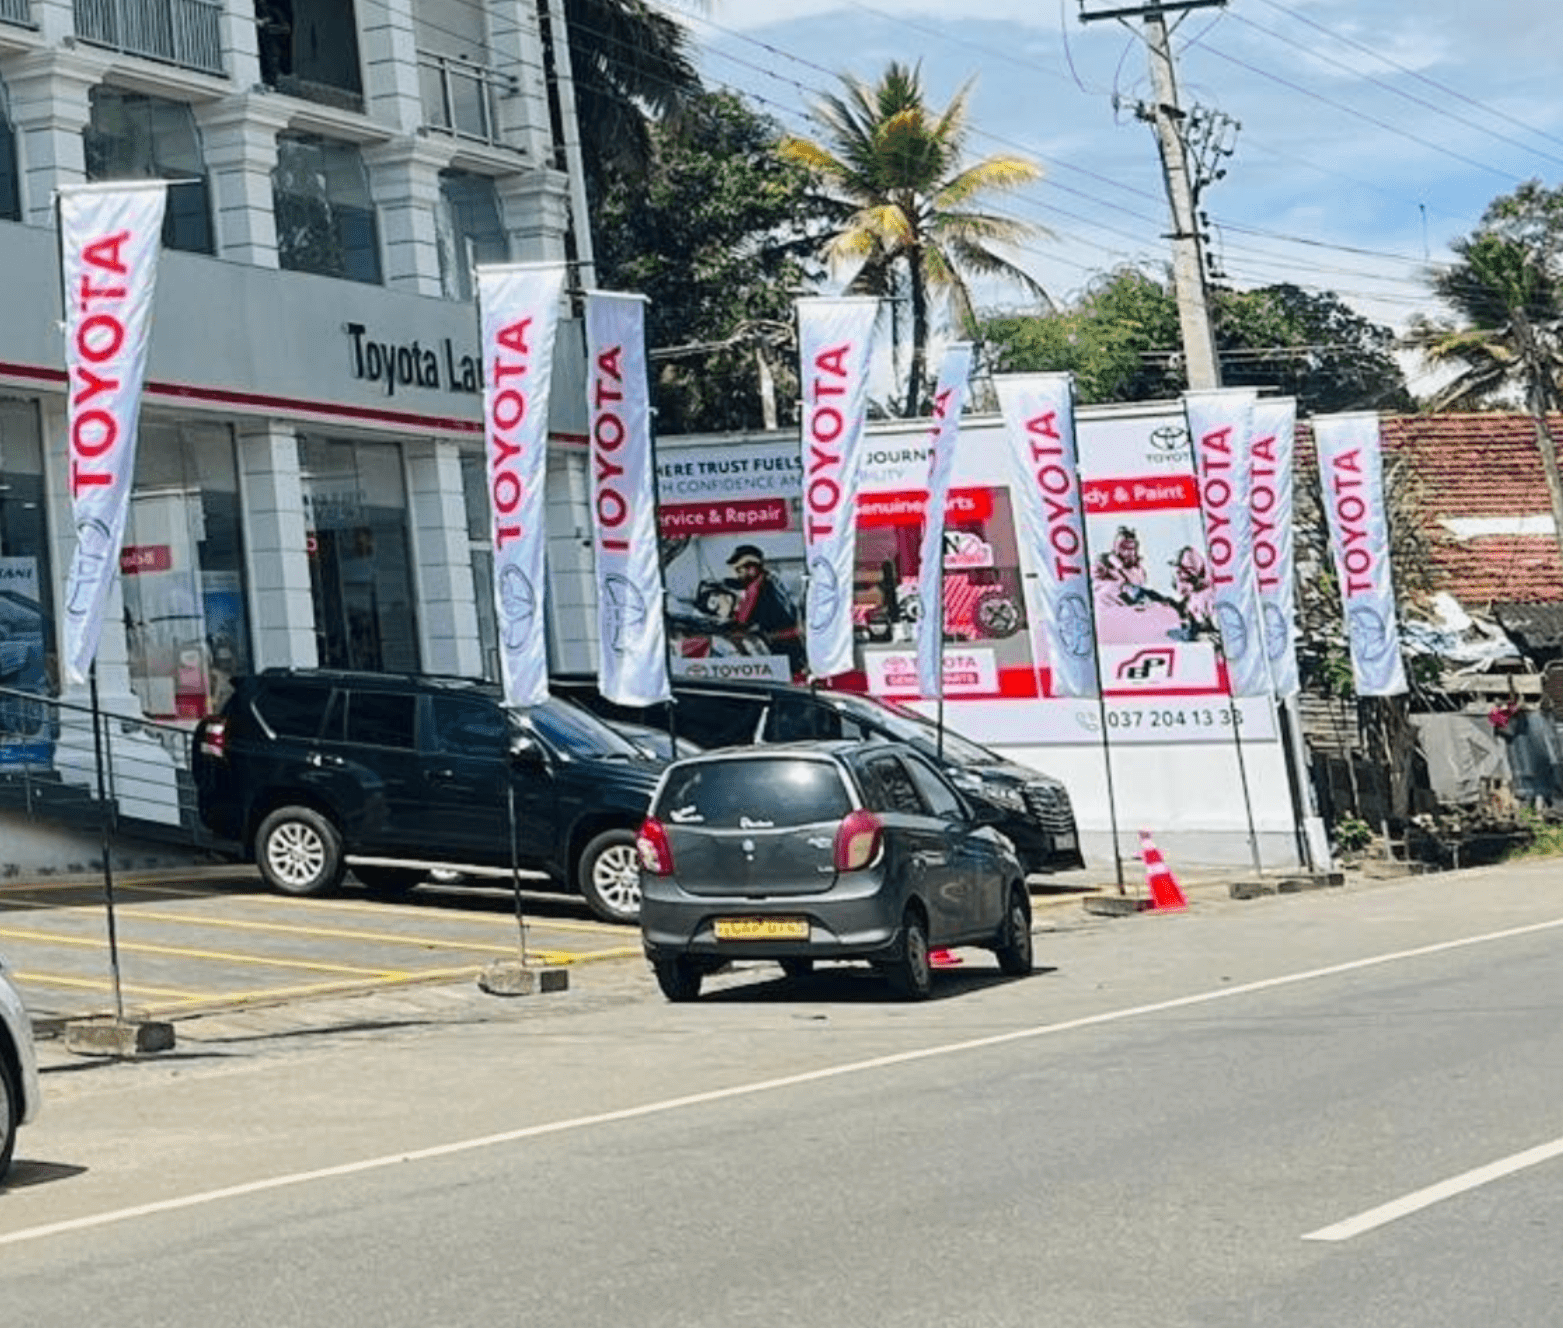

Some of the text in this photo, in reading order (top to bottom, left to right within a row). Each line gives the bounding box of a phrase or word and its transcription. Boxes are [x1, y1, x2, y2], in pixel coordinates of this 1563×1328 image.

[70, 228, 131, 499] TOYOTA
[346, 322, 440, 396] Toyota
[490, 316, 532, 548] TOYOTA
[676, 475, 775, 494] CONFIDENCE
[697, 459, 749, 474] TRUST
[807, 343, 851, 546] TOYOTA
[708, 508, 723, 526] &
[725, 504, 783, 526] Repair
[1026, 411, 1083, 583] TOYOTA
[1112, 485, 1130, 504] &
[1132, 483, 1186, 503] Paint
[1201, 426, 1234, 590] TOYOTA
[1250, 433, 1277, 593] TOYOTA
[1332, 448, 1373, 598] TOYOTA
[710, 662, 773, 677] TOYOTA
[1108, 711, 1143, 728] 037
[1149, 709, 1186, 727] 204
[1192, 708, 1214, 726] 13
